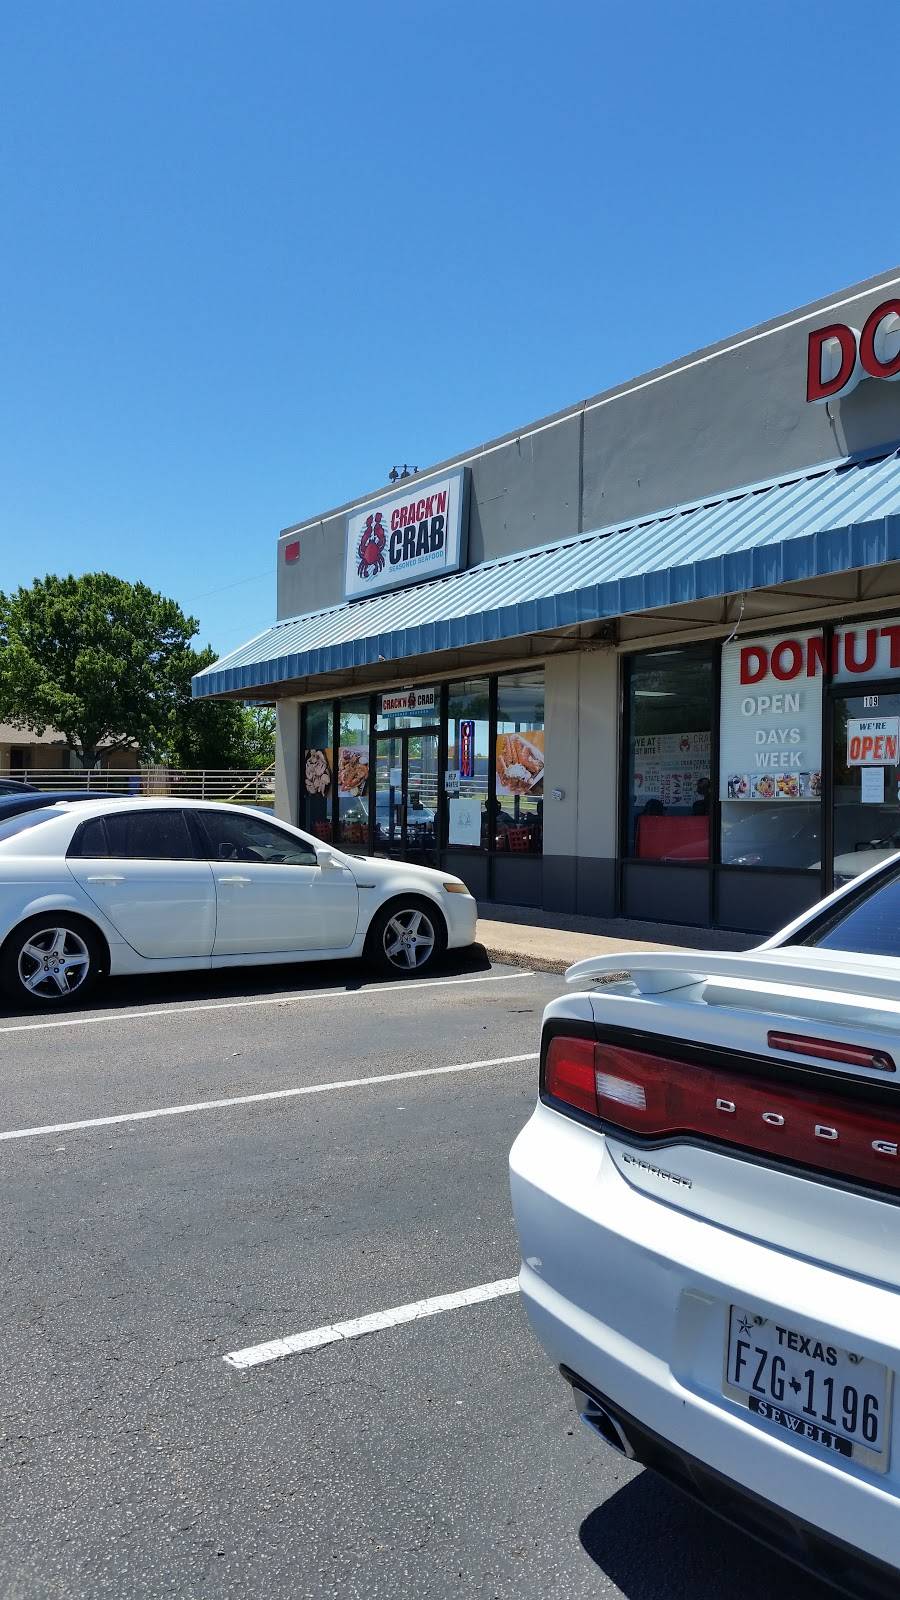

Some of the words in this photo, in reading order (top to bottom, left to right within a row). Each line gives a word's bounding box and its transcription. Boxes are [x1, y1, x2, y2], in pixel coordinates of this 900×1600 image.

[391, 491, 447, 531] CRACK'N
[389, 515, 445, 565] CRAB
[389, 560, 417, 573] SEASONED
[418, 551, 444, 564] SEAFOOD
[383, 697, 407, 710] CRACK'N
[417, 693, 434, 706] CRAB
[741, 693, 801, 717] OPEN
[864, 696, 879, 707] 109
[755, 728, 801, 745] DAYS
[859, 721, 887, 731] WE'RE
[755, 751, 802, 768] WEEK
[850, 735, 898, 761] OPEN
[621, 1152, 693, 1190] CHARGER
[775, 1325, 838, 1367] TEXAS
[757, 1401, 842, 1452] SEWELL
